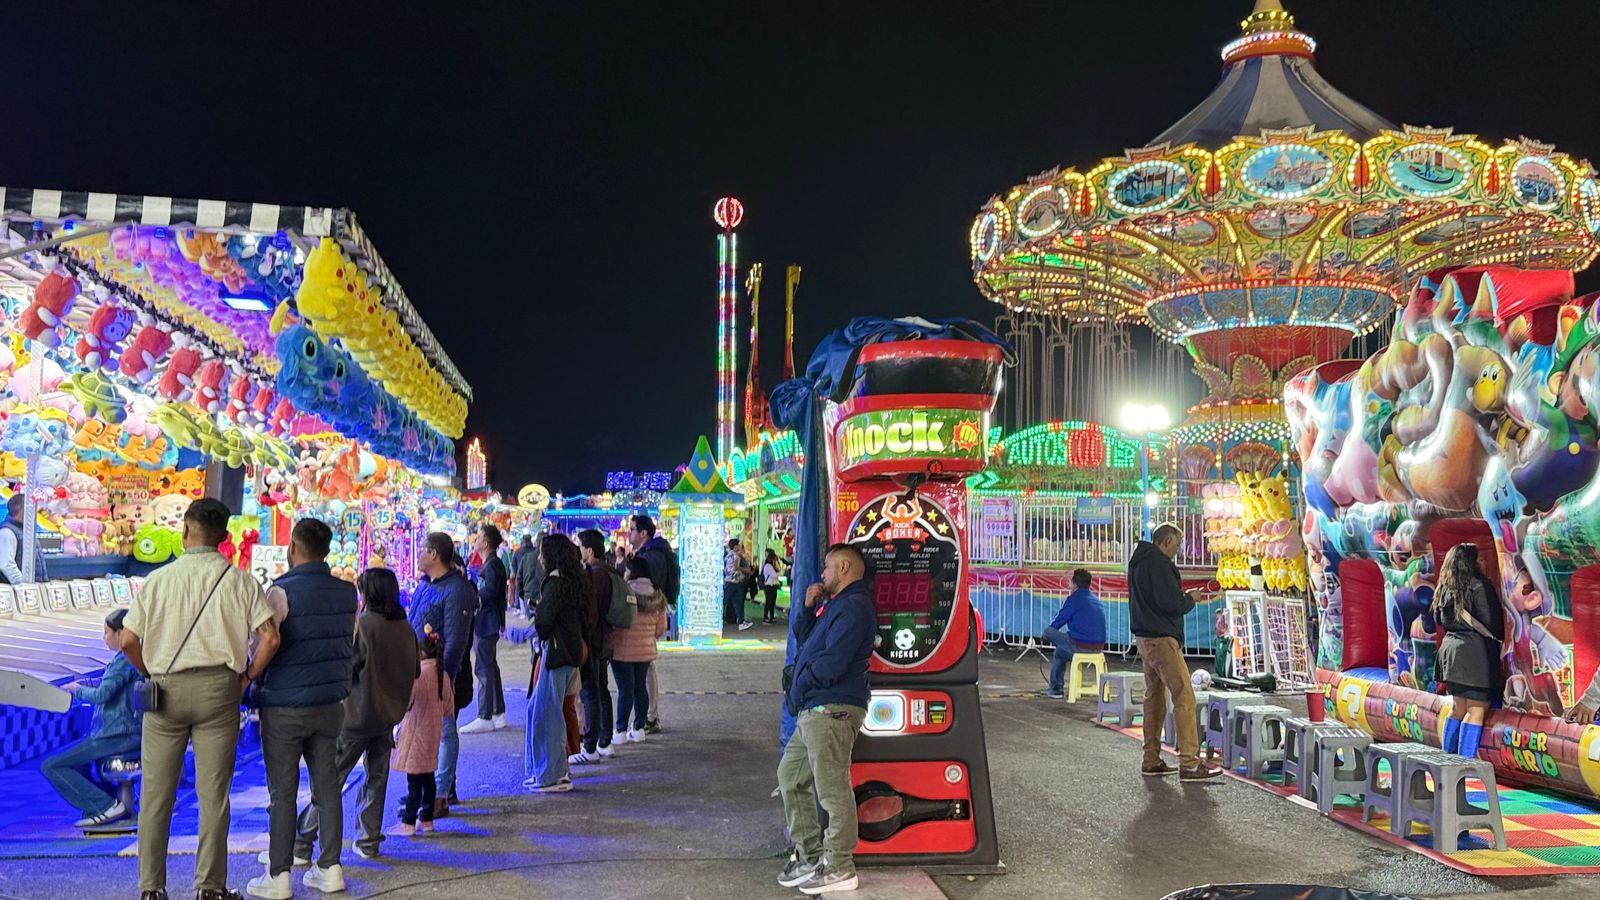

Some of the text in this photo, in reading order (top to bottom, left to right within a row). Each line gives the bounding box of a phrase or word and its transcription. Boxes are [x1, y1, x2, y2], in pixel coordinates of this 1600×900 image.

[606, 471, 634, 489] ICE
[838, 500, 859, 512] $10
[346, 511, 360, 527] 15
[377, 510, 390, 525] 15
[886, 528, 920, 538] BOXER
[890, 649, 919, 658] KICKER
[1385, 698, 1419, 721] SUPER
[1384, 714, 1424, 743] MARIO
[1503, 726, 1548, 752] SUPER
[1500, 744, 1559, 778] MARIO
